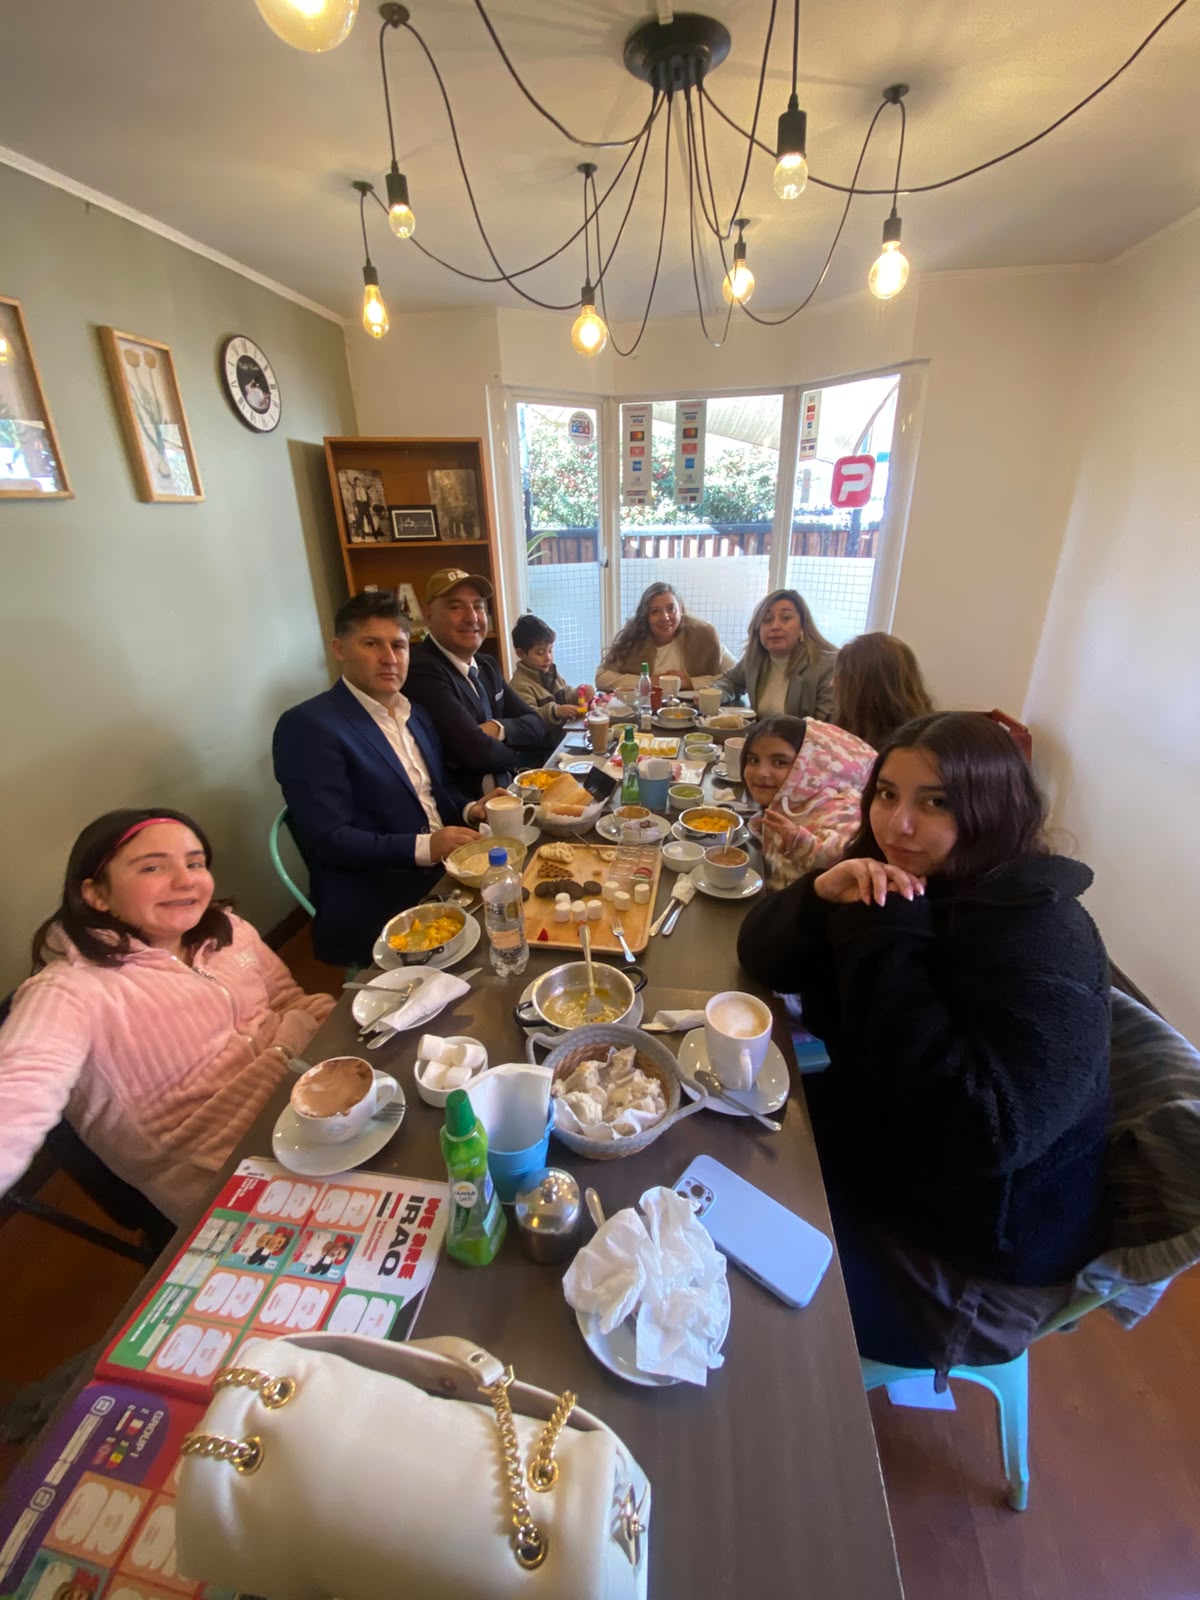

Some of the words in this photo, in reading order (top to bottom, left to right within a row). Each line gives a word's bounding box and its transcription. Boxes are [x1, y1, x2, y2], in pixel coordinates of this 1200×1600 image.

[377, 1195, 426, 1277] IRAQ
[417, 1197, 443, 1230] WE
[398, 1233, 427, 1281] ARE
[135, 1410, 165, 1452] GROUP
